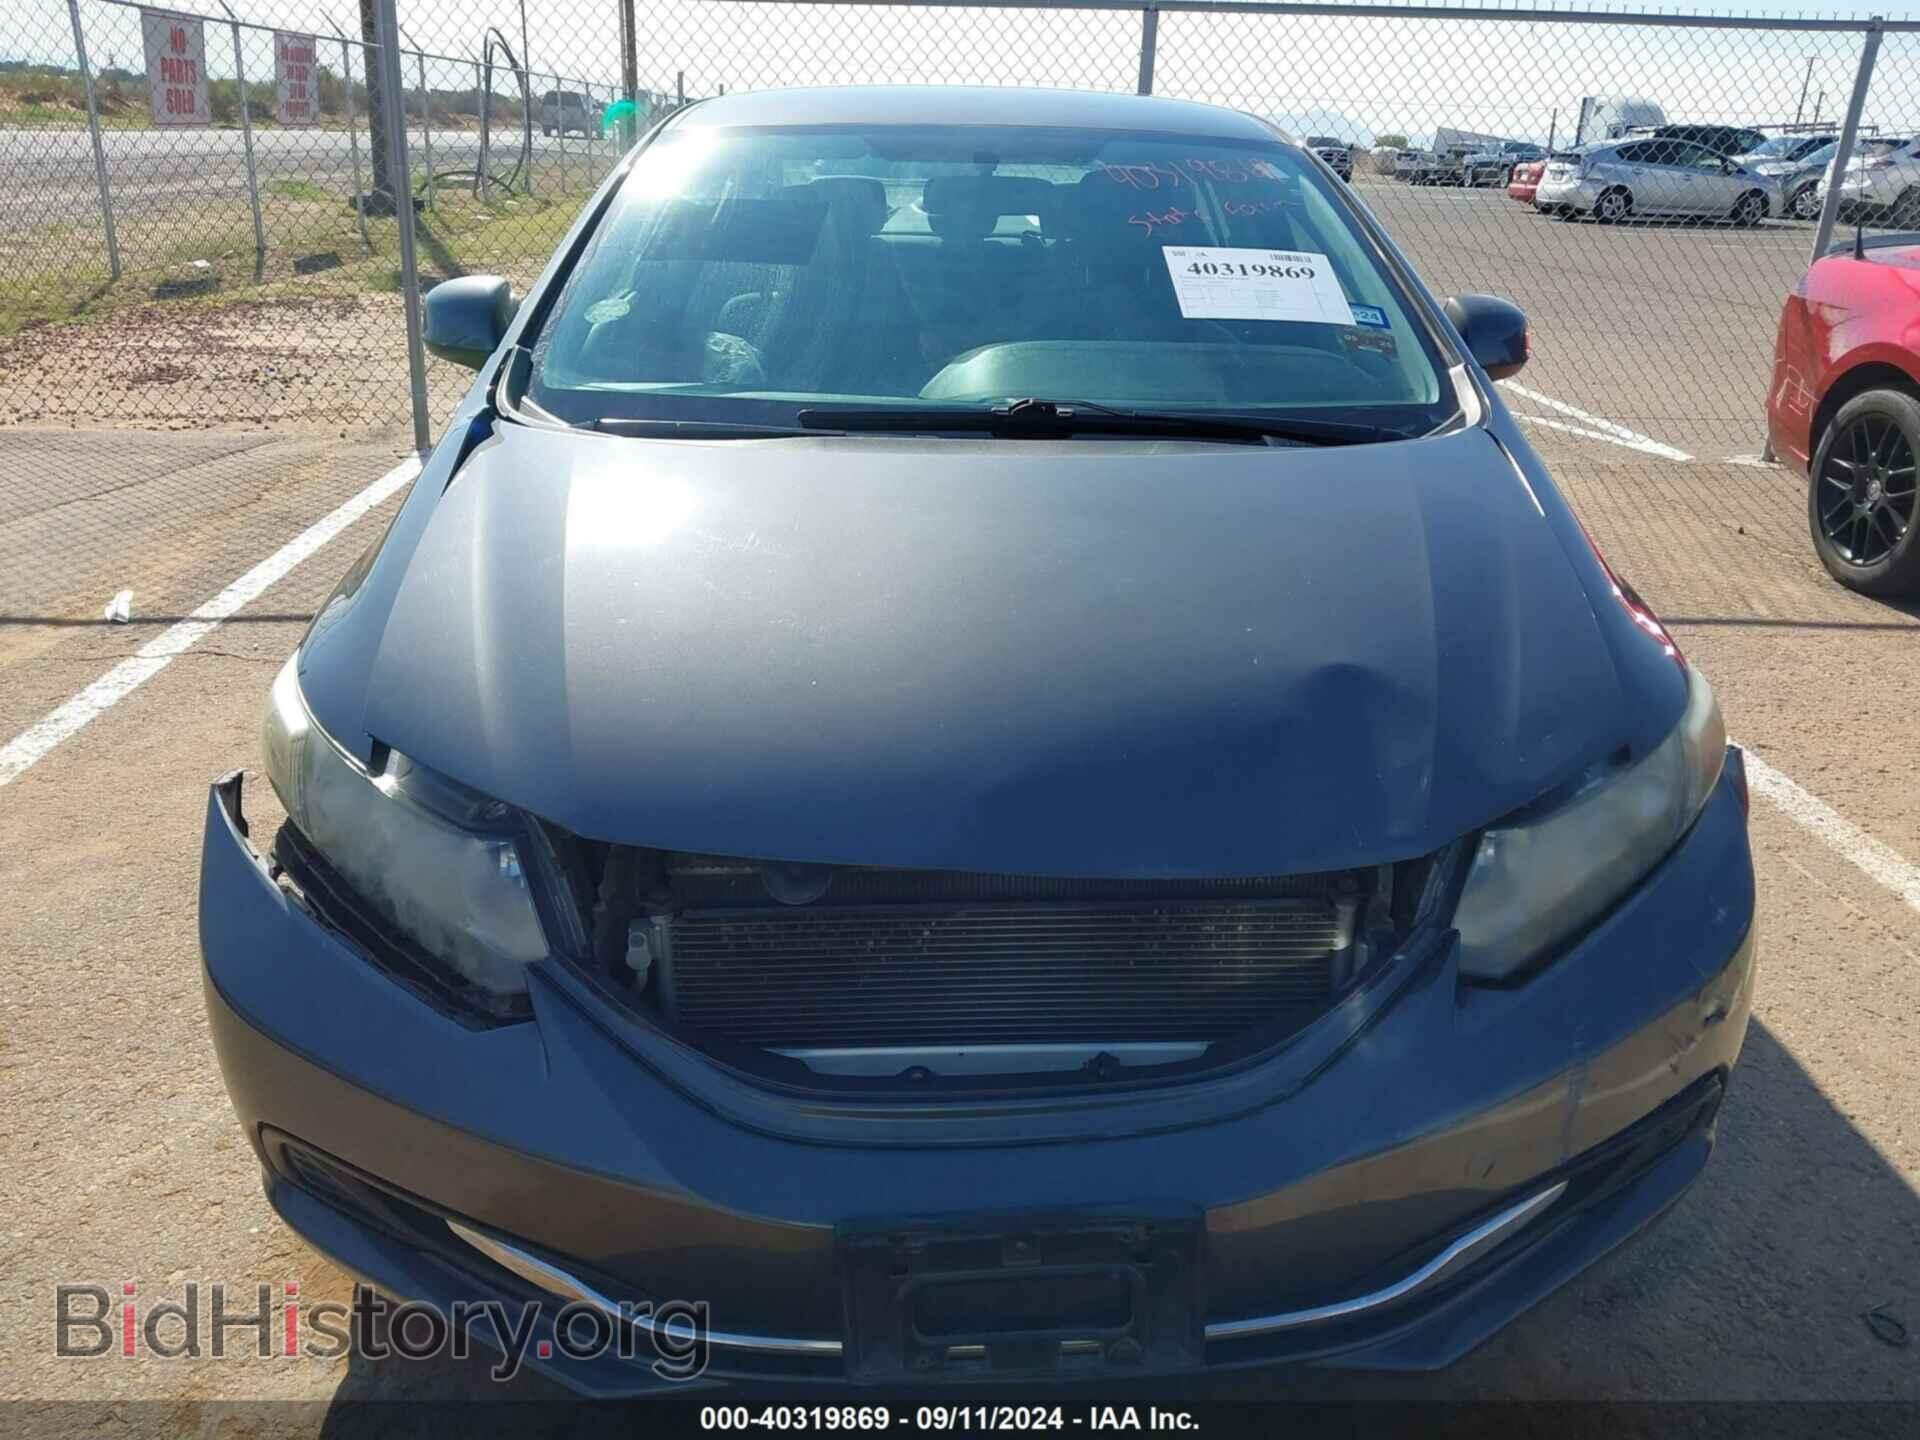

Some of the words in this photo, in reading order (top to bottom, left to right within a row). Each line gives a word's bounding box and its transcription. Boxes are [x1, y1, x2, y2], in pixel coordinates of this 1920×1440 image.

[169, 25, 185, 54] NO
[160, 56, 197, 84] PARTS
[166, 87, 195, 114] SOLD
[1186, 261, 1316, 281] 40319869
